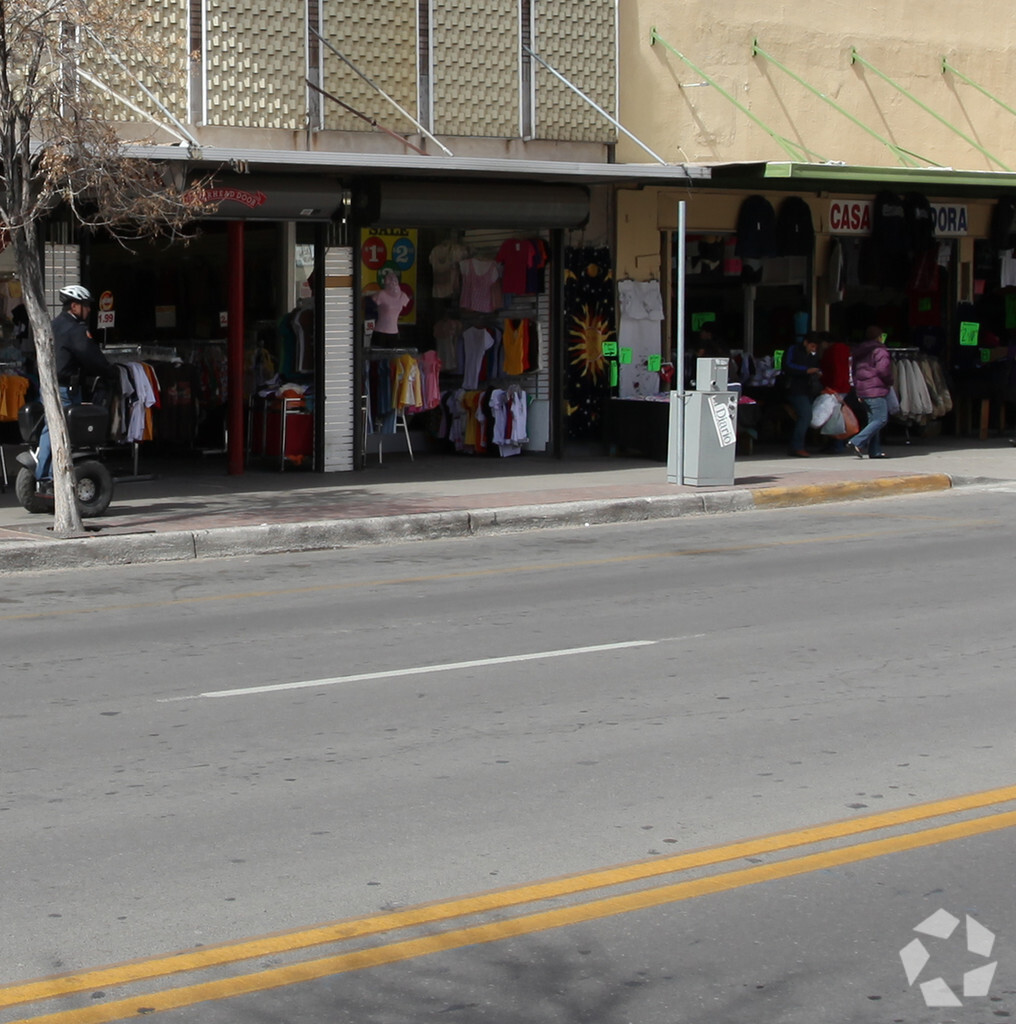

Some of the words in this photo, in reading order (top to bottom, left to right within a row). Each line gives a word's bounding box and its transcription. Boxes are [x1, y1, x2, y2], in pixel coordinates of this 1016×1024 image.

[236, 192, 257, 207] DOOR
[830, 203, 871, 230] CASA
[930, 207, 967, 232] DORA
[98, 313, 114, 323] 1.99
